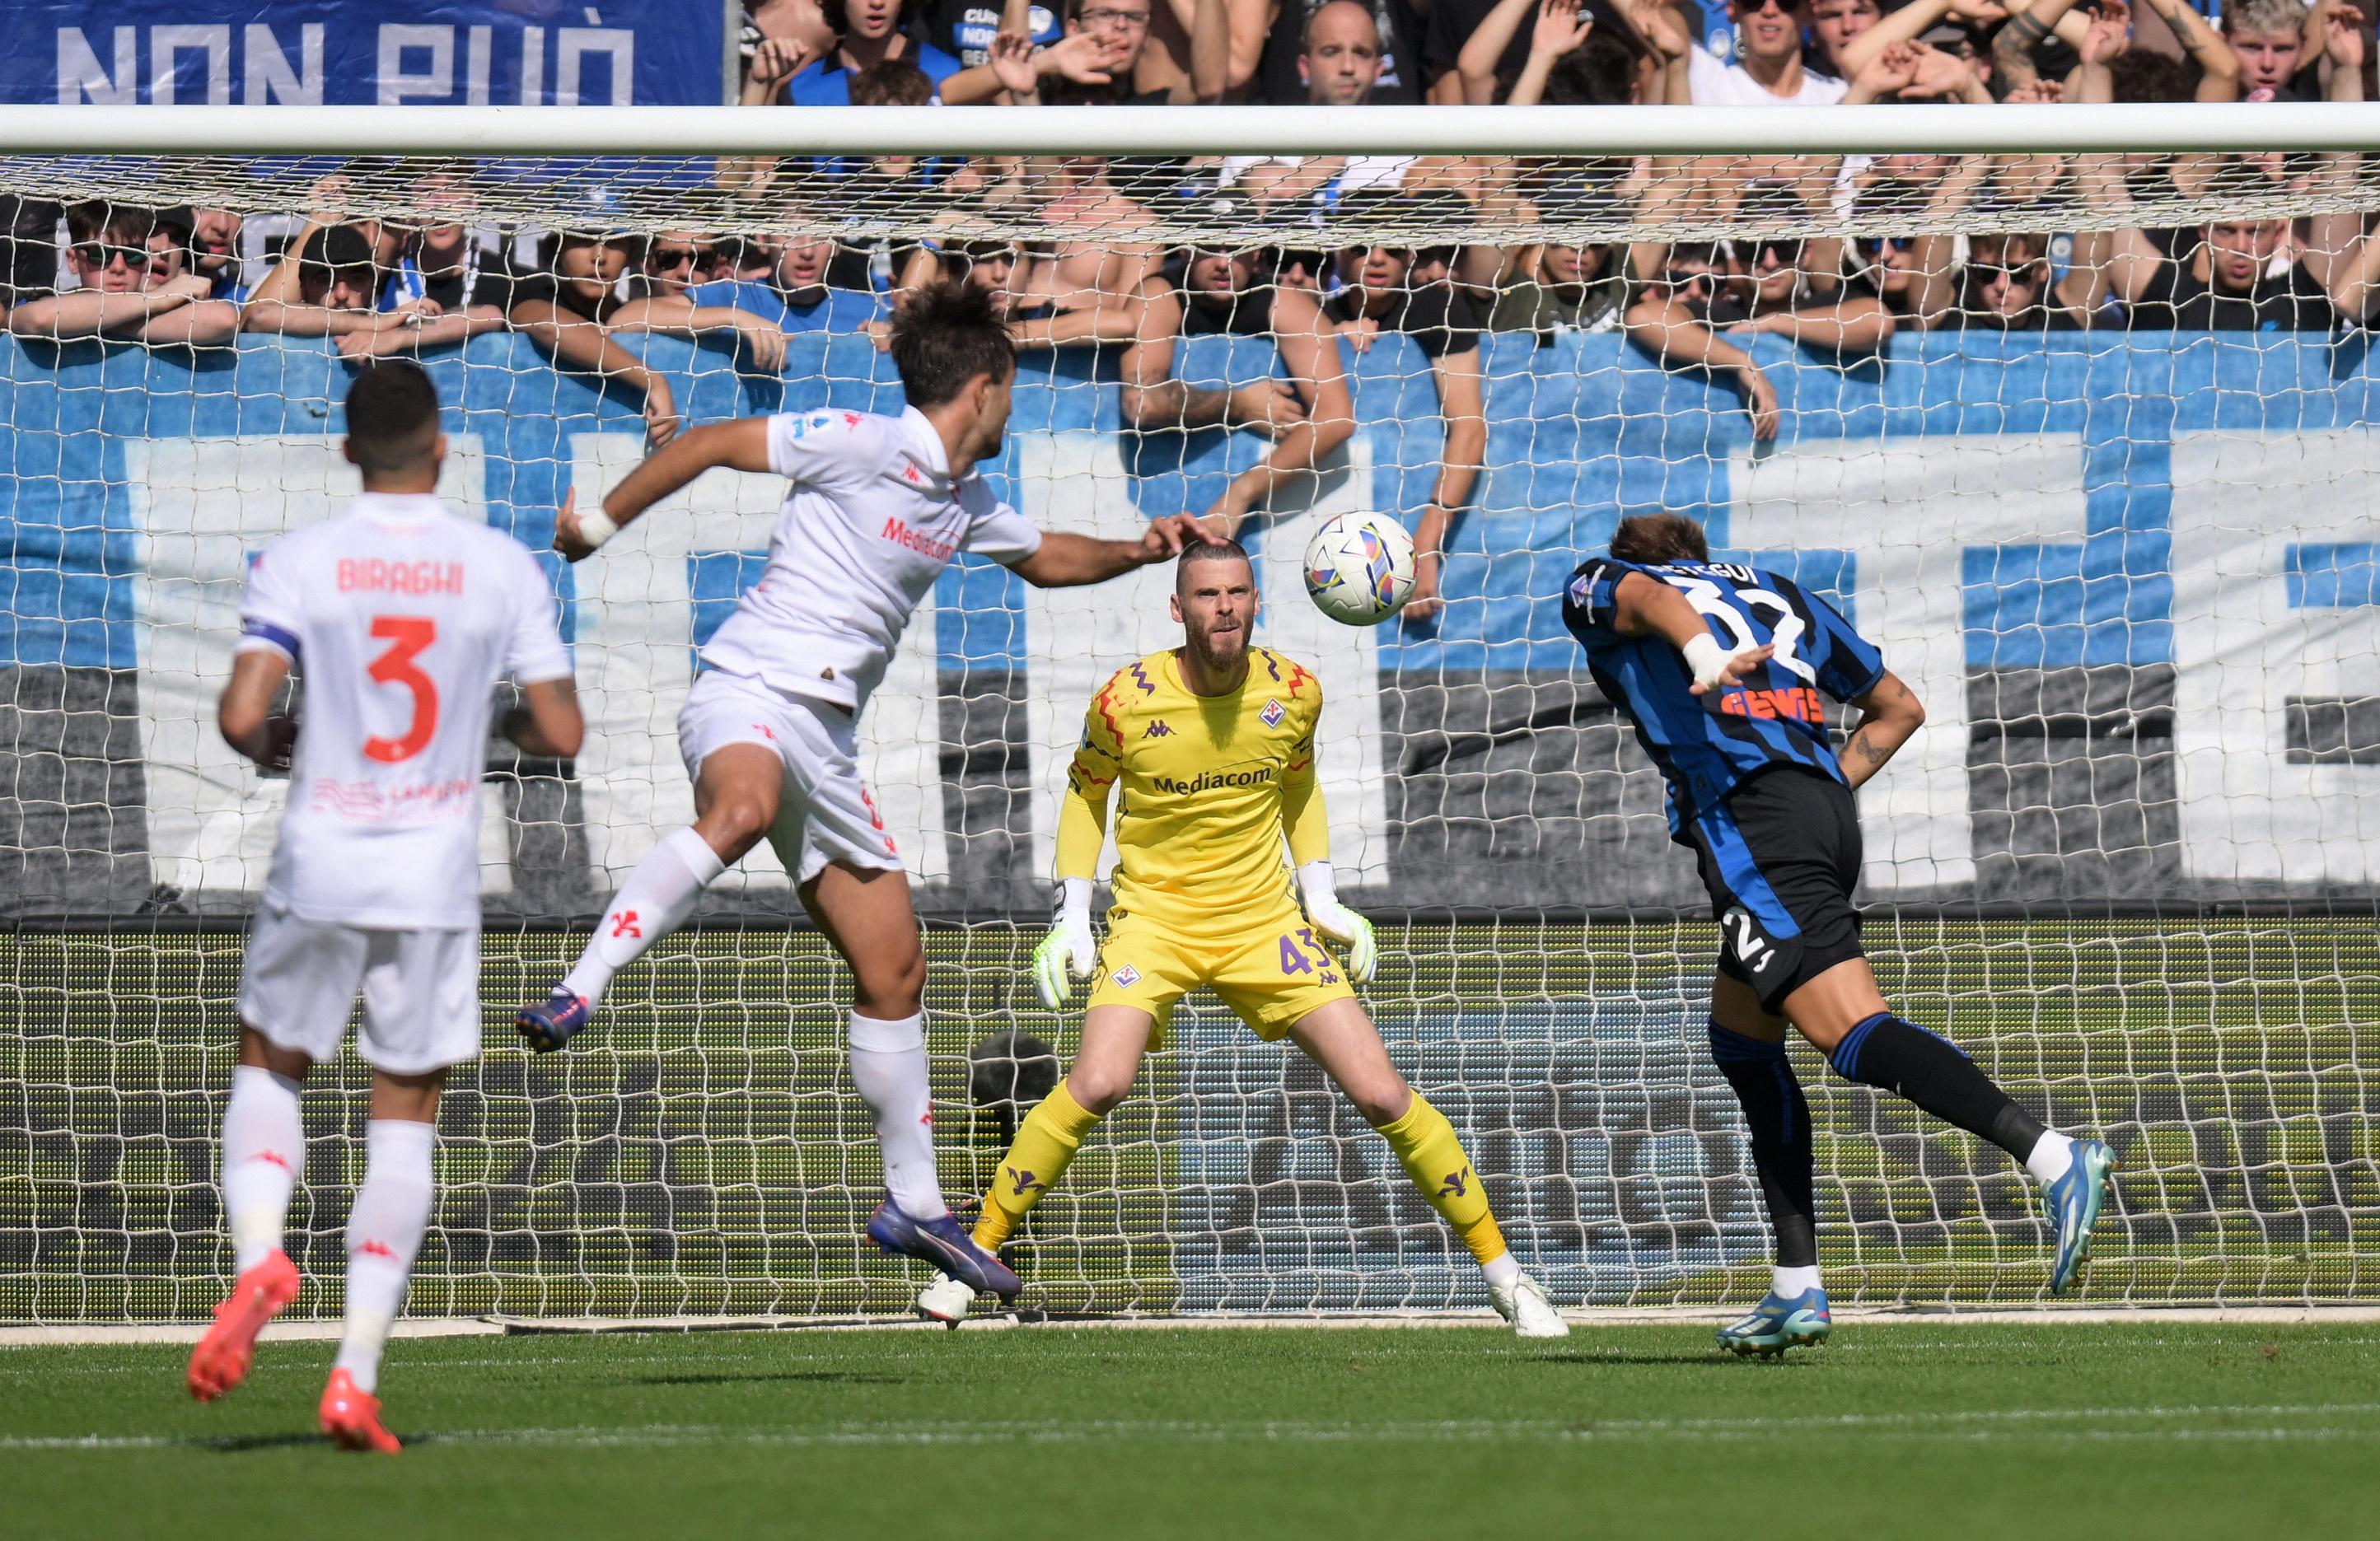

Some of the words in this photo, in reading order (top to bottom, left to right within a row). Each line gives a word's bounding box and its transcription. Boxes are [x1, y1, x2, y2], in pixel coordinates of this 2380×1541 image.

[57, 22, 325, 105] NON
[377, 6, 635, 105] PUÒ
[880, 516, 956, 562] Mediacom
[338, 558, 465, 595] BIRAGHI
[1661, 576, 1817, 687] 32
[363, 615, 440, 763] 3
[1721, 687, 1826, 722] GEWIS
[1153, 765, 1271, 796] Mediacom
[1279, 928, 1330, 976] 43
